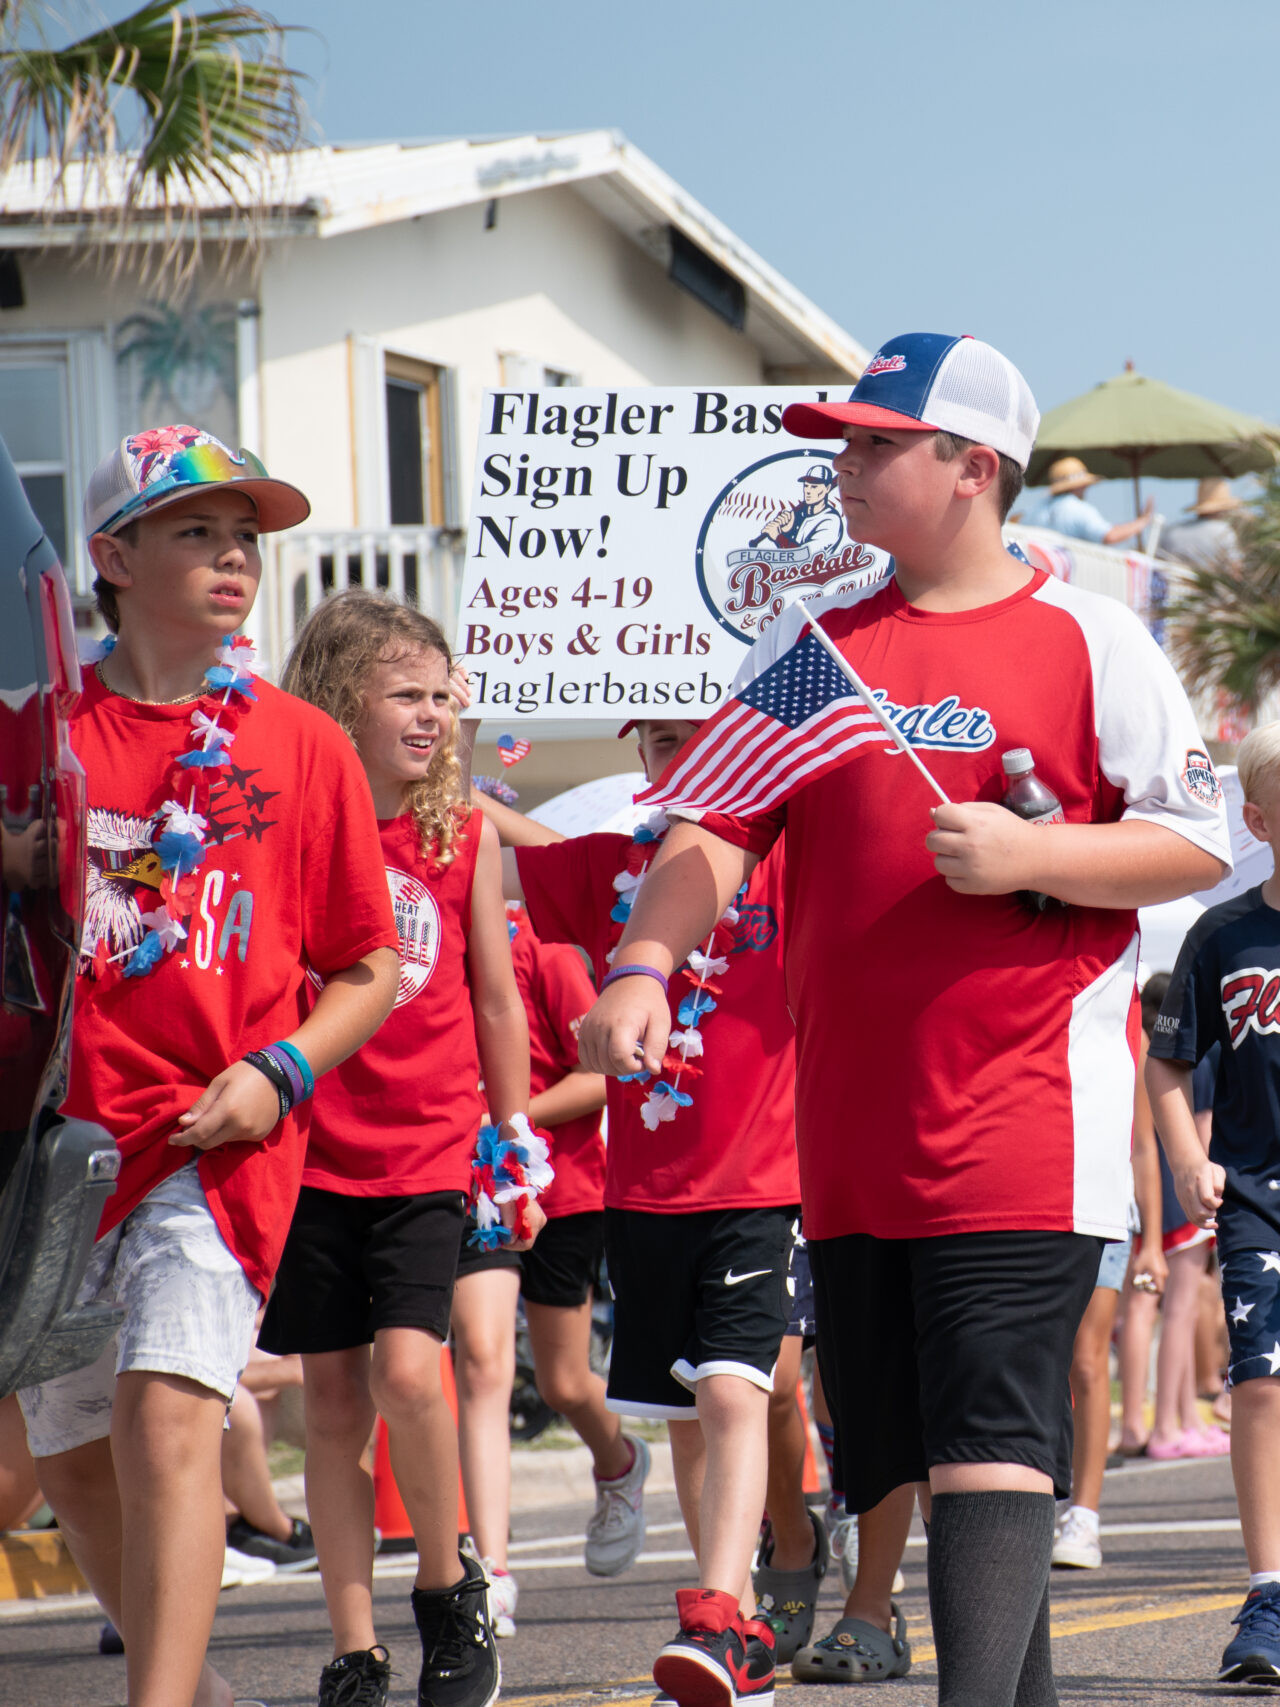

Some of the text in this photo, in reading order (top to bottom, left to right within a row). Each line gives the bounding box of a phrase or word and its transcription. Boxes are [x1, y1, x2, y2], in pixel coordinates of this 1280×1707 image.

[485, 391, 829, 448] Flagler Bas
[479, 452, 688, 510] Sign Up
[471, 514, 611, 559] Now!
[740, 552, 795, 562] FLAGLER
[466, 576, 653, 618] Ages 4-19
[726, 544, 874, 612] Baseball
[464, 623, 711, 665] Boys & Girls
[467, 671, 733, 713] laglerbaseb
[1186, 768, 1217, 790] RIPKEN
[395, 901, 420, 917] HEAT
